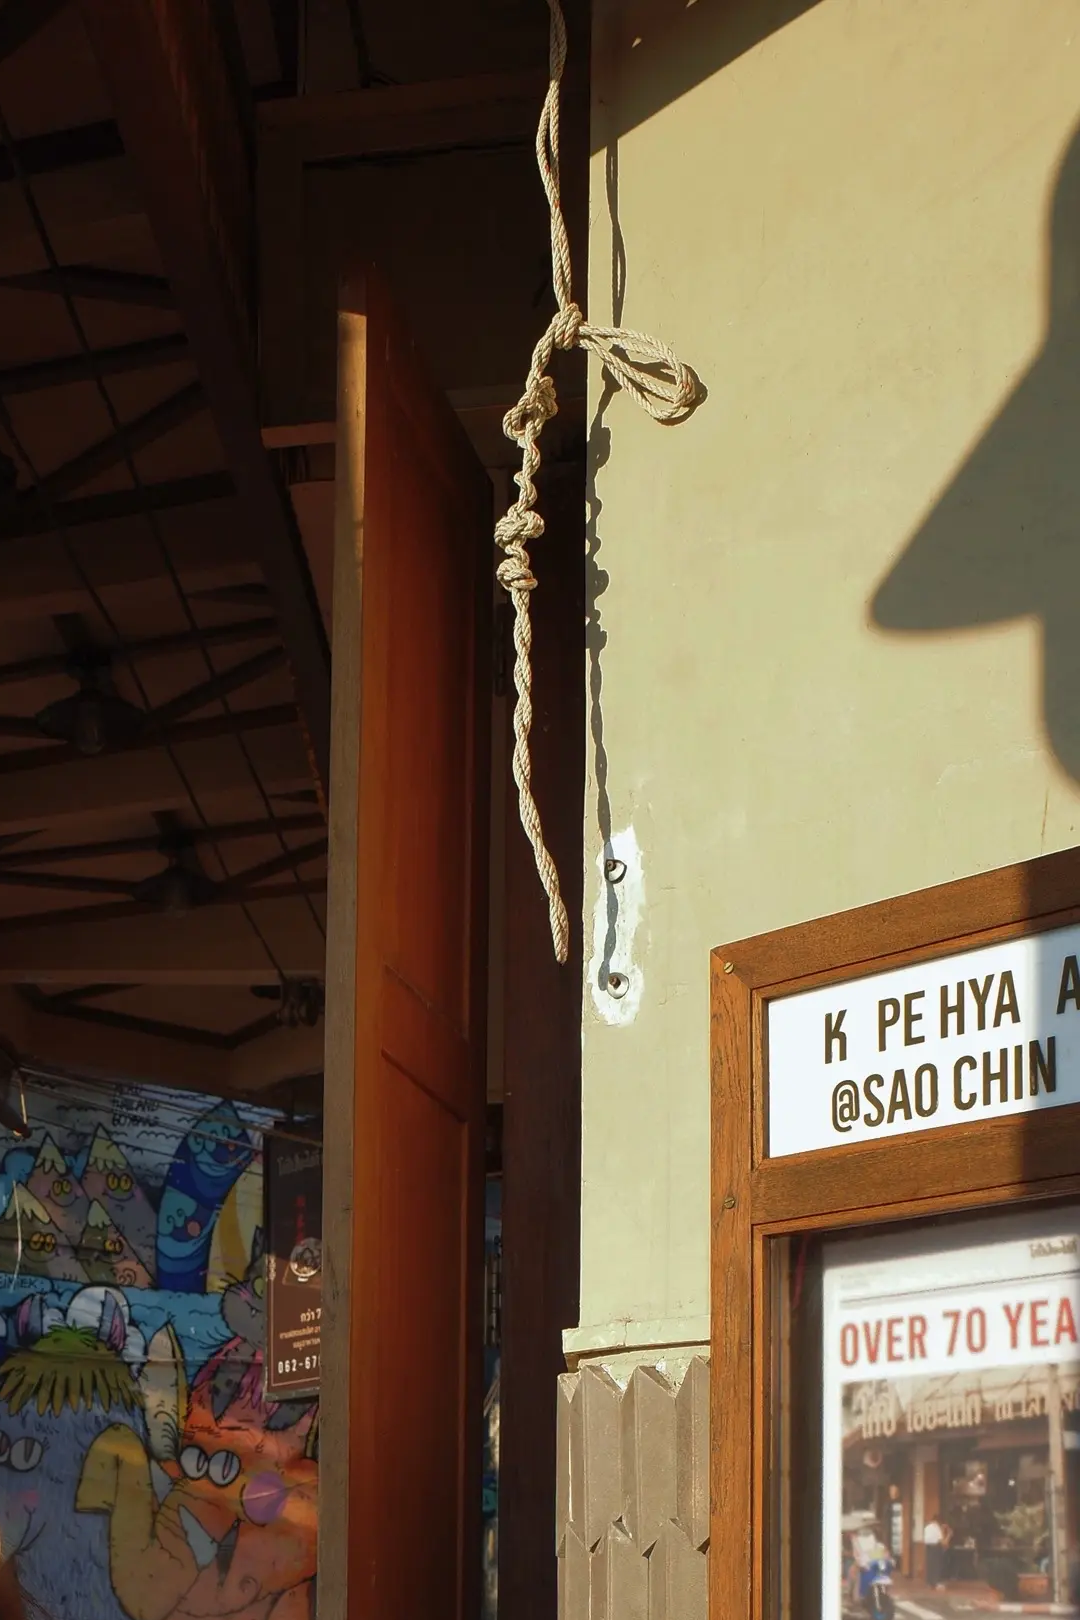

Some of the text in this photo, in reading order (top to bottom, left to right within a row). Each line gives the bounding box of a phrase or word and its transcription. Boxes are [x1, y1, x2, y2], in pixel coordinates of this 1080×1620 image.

[824, 1009, 847, 1064] K
[878, 990, 925, 1052] PE
[940, 969, 1021, 1039] HYA
[832, 1036, 1056, 1133] @SAO CHIN
[277, 1354, 320, 1374] 062-67
[840, 1297, 1078, 1367] OVER 70 YEA
